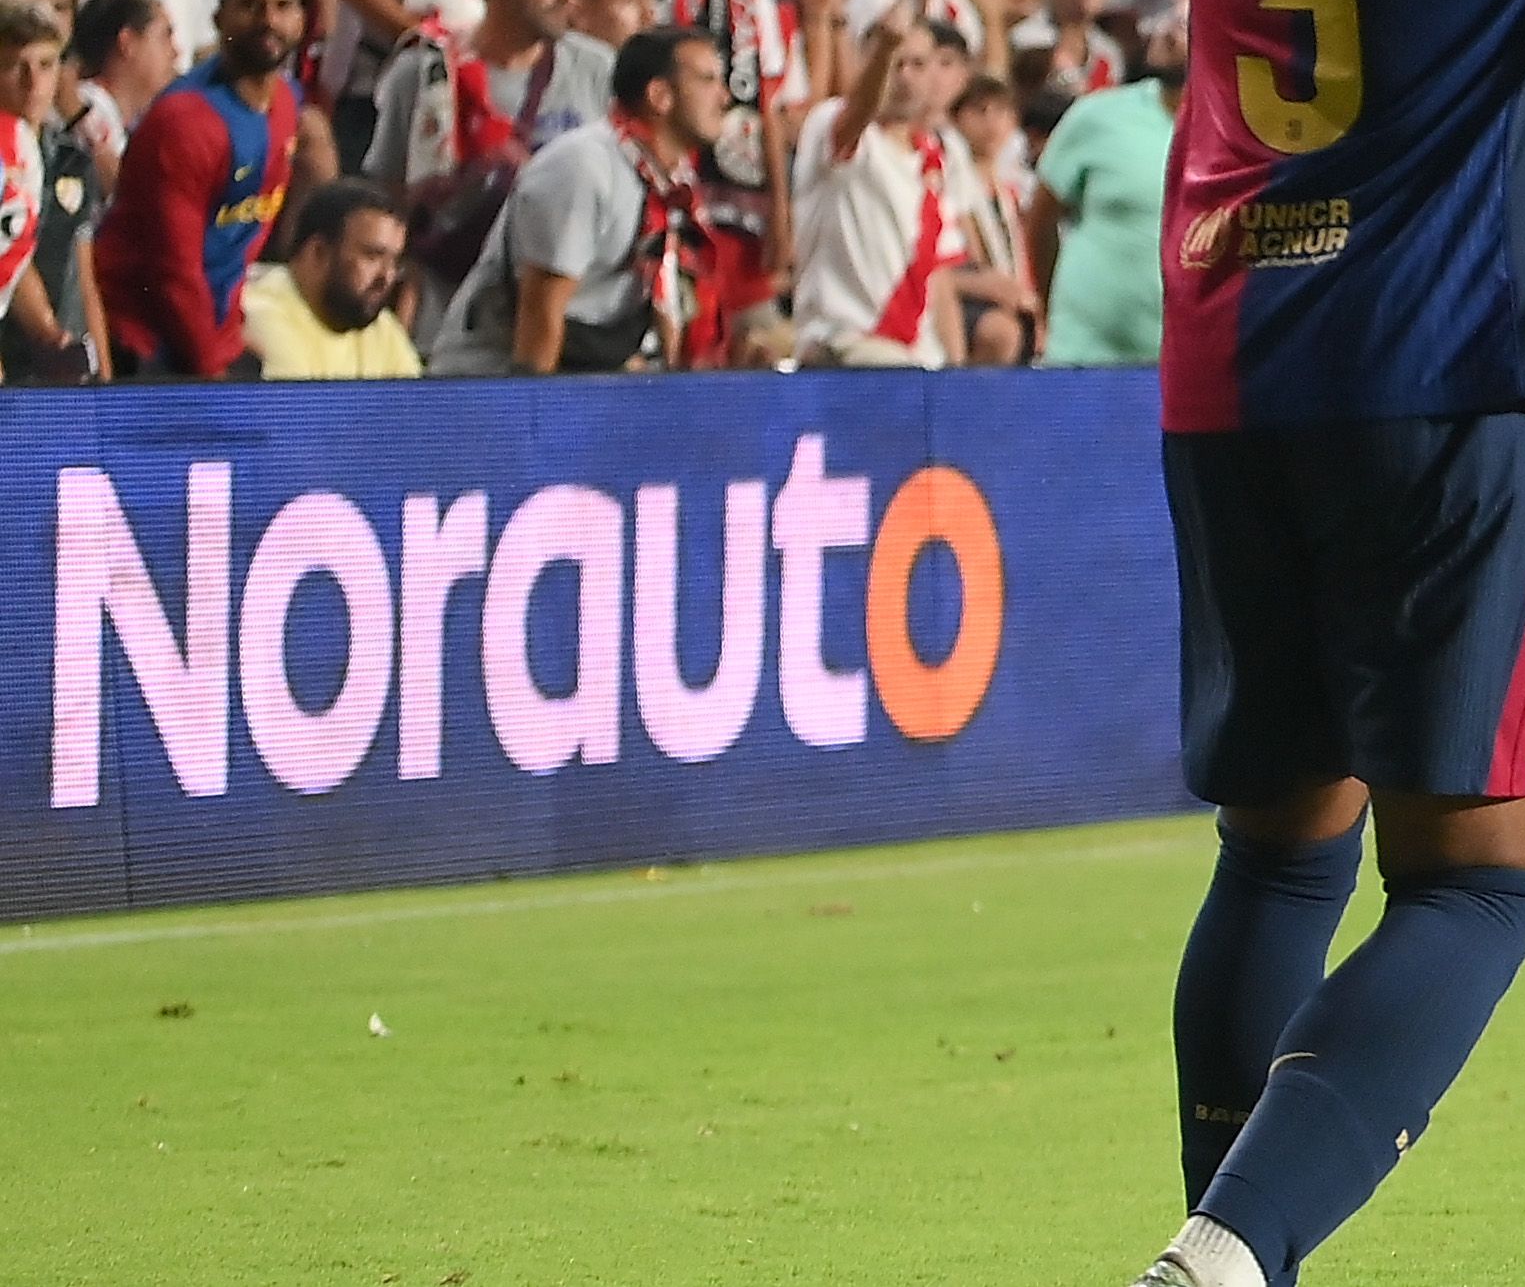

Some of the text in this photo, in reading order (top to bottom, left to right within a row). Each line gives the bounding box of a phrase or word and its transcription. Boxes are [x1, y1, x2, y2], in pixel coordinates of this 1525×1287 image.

[1238, 198, 1350, 229] UNHCR
[1238, 226, 1349, 258] ACNUR
[49, 432, 1006, 810] Norauto
